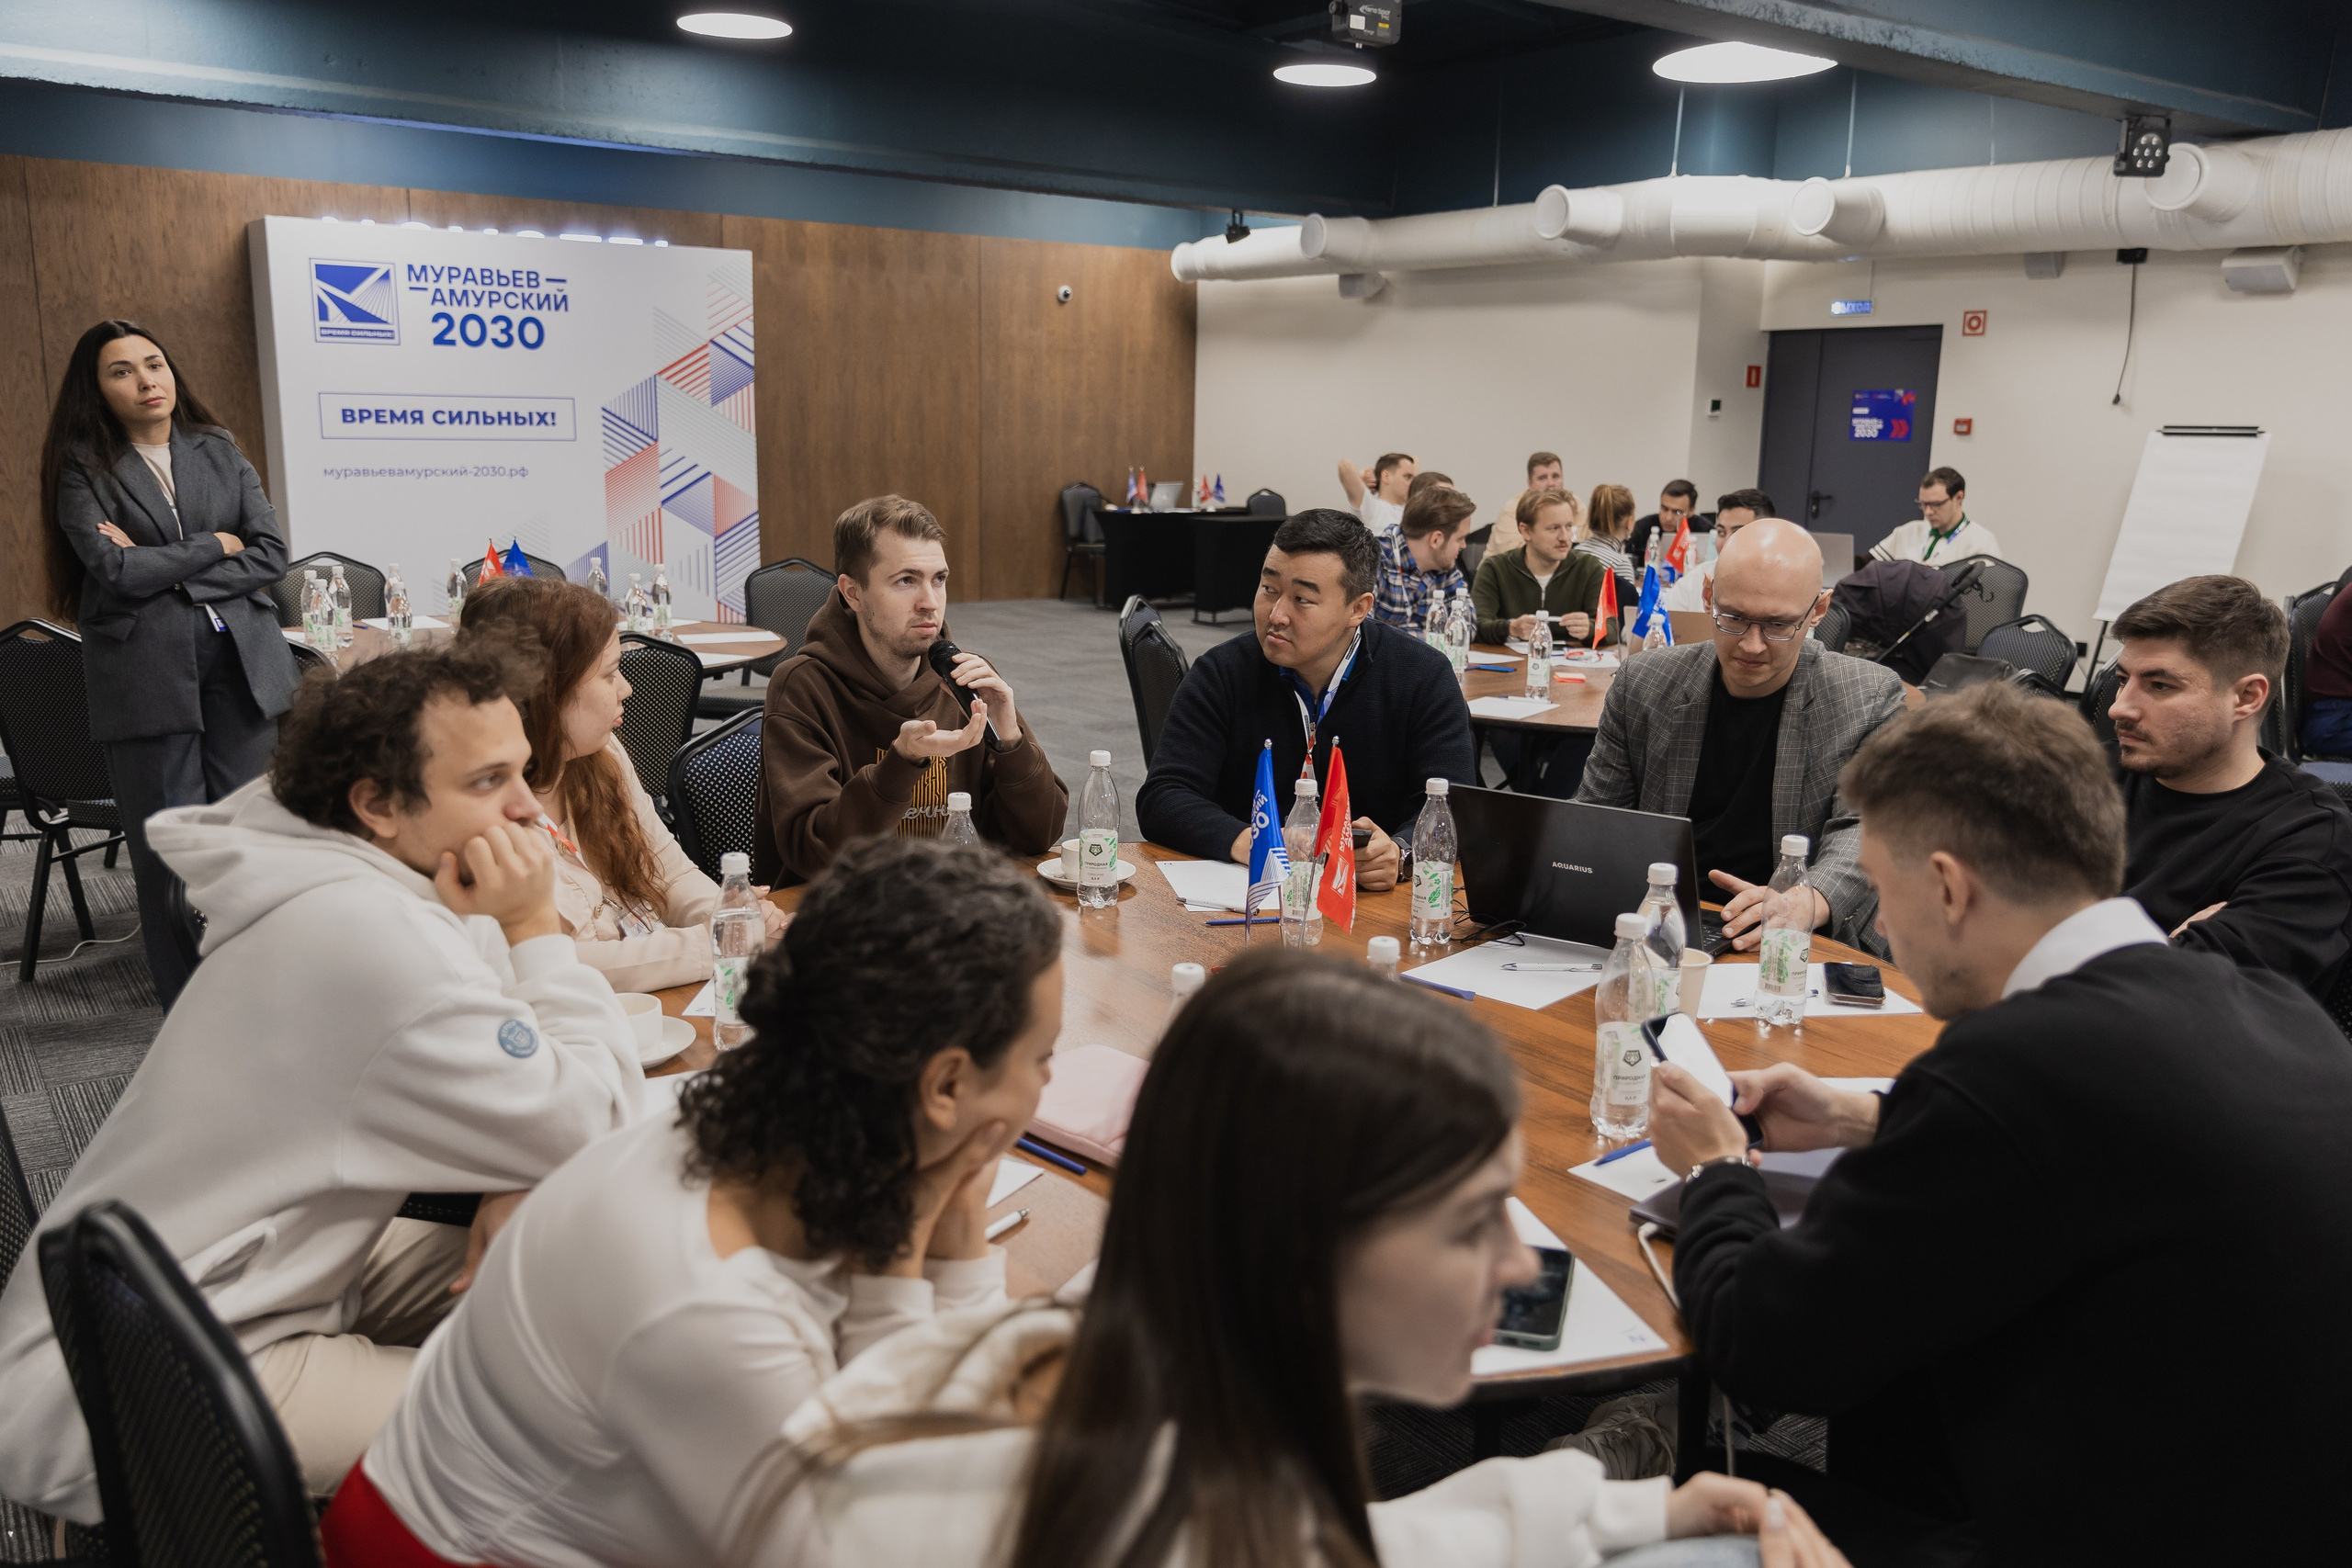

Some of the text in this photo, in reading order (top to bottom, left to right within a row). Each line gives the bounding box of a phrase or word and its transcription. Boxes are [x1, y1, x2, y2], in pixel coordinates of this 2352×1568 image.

[431, 311, 545, 350] 2030
[341, 408, 557, 426] ВРЕМЯ СИЛЬНЫХ!
[323, 466, 529, 479] муравьевамурский-2030.рф
[1552, 861, 1593, 874] AQUARIUS
